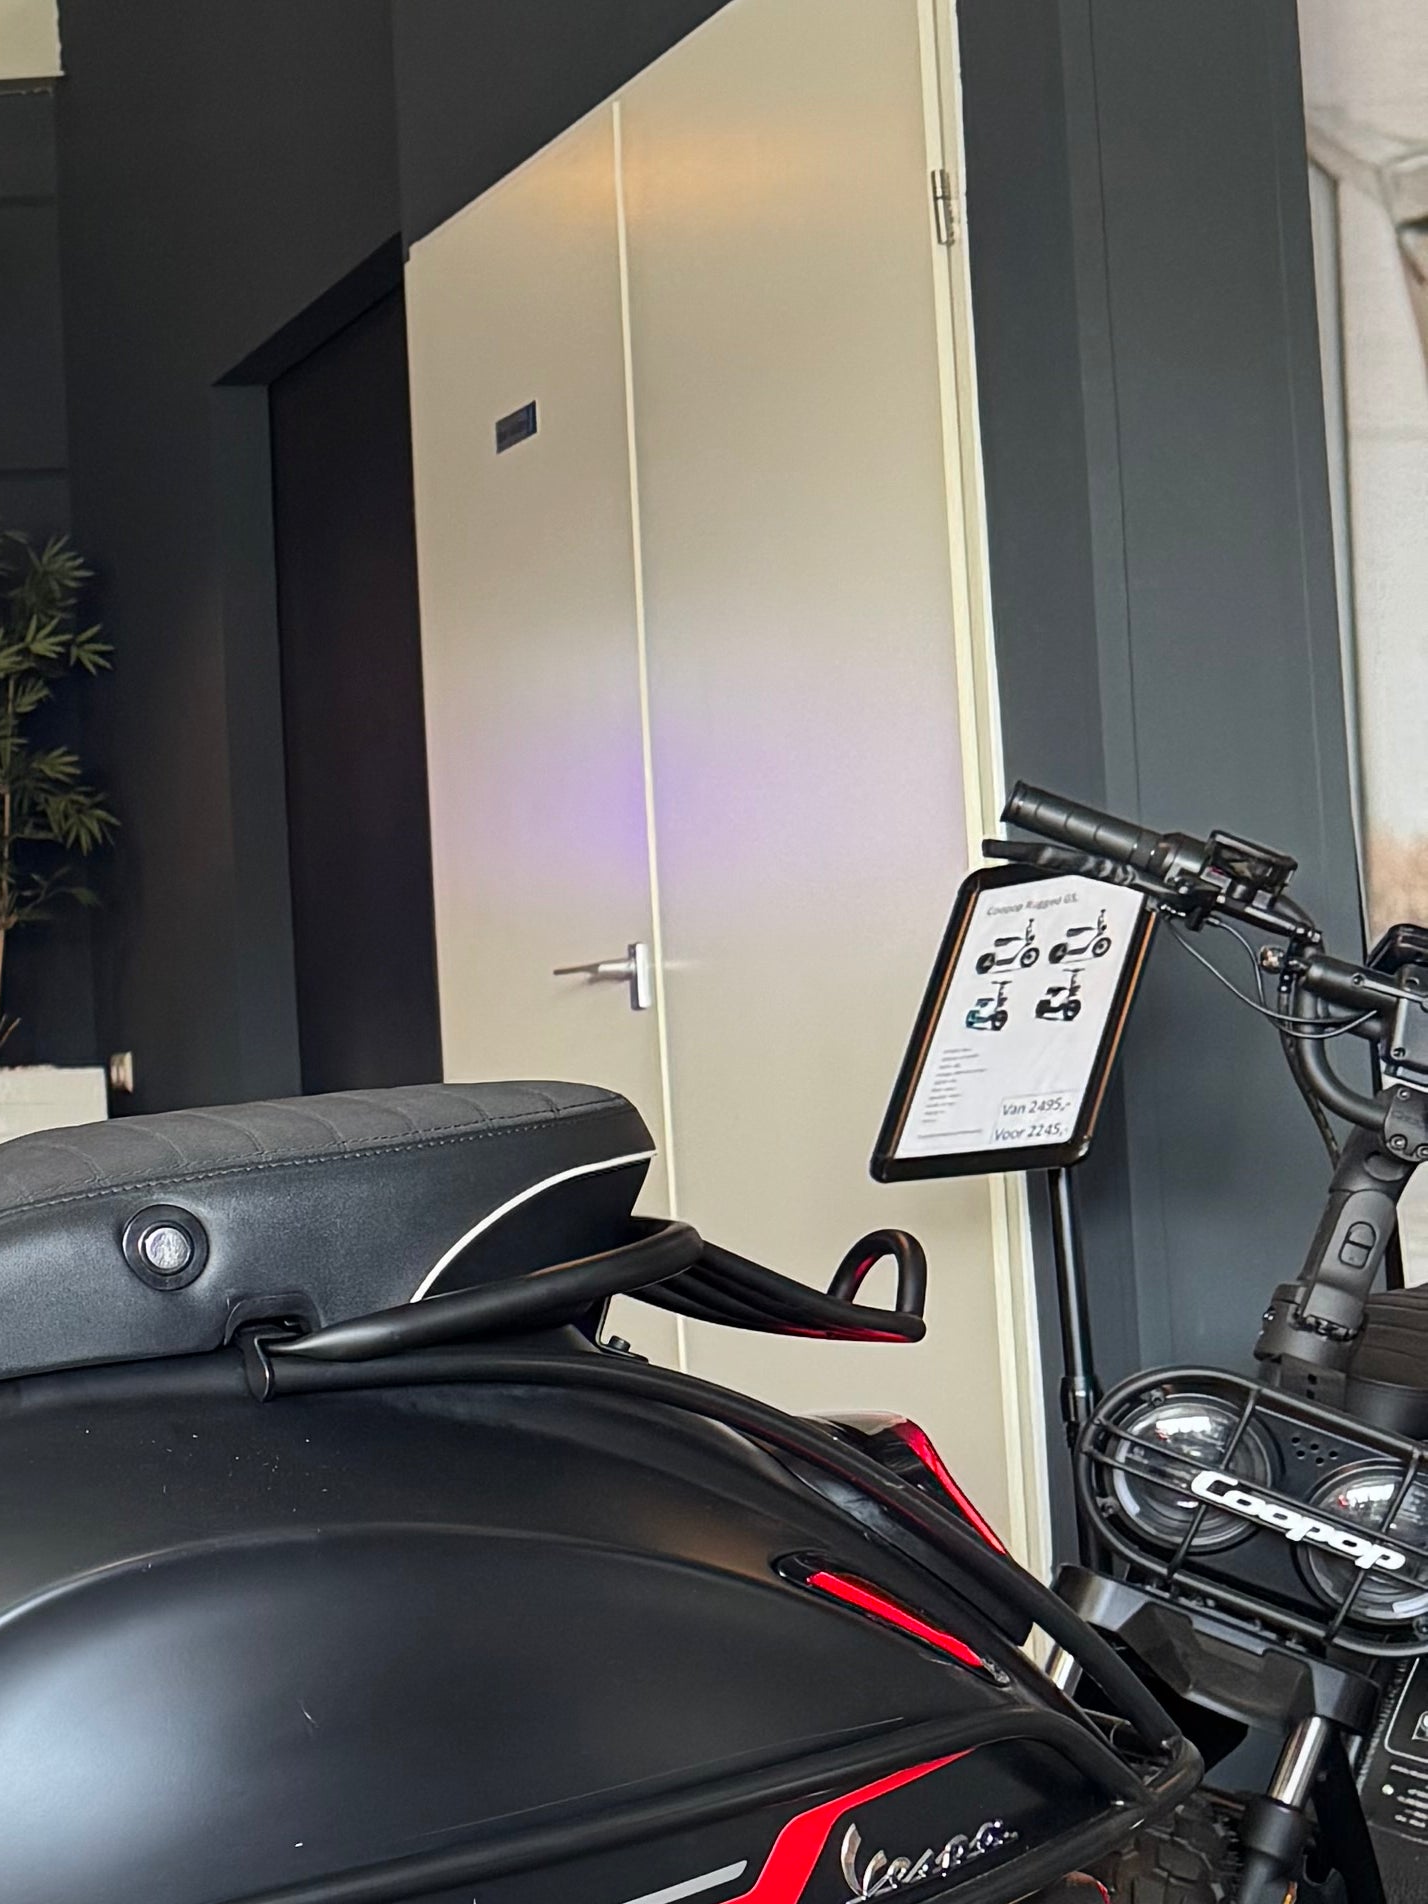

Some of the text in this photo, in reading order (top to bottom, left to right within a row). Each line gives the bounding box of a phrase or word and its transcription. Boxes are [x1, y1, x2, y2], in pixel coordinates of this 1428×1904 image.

[1002, 1097, 1071, 1116] Van 2495,-
[995, 1128, 1025, 1141] Voor
[1191, 1470, 1407, 1572] Coopop
